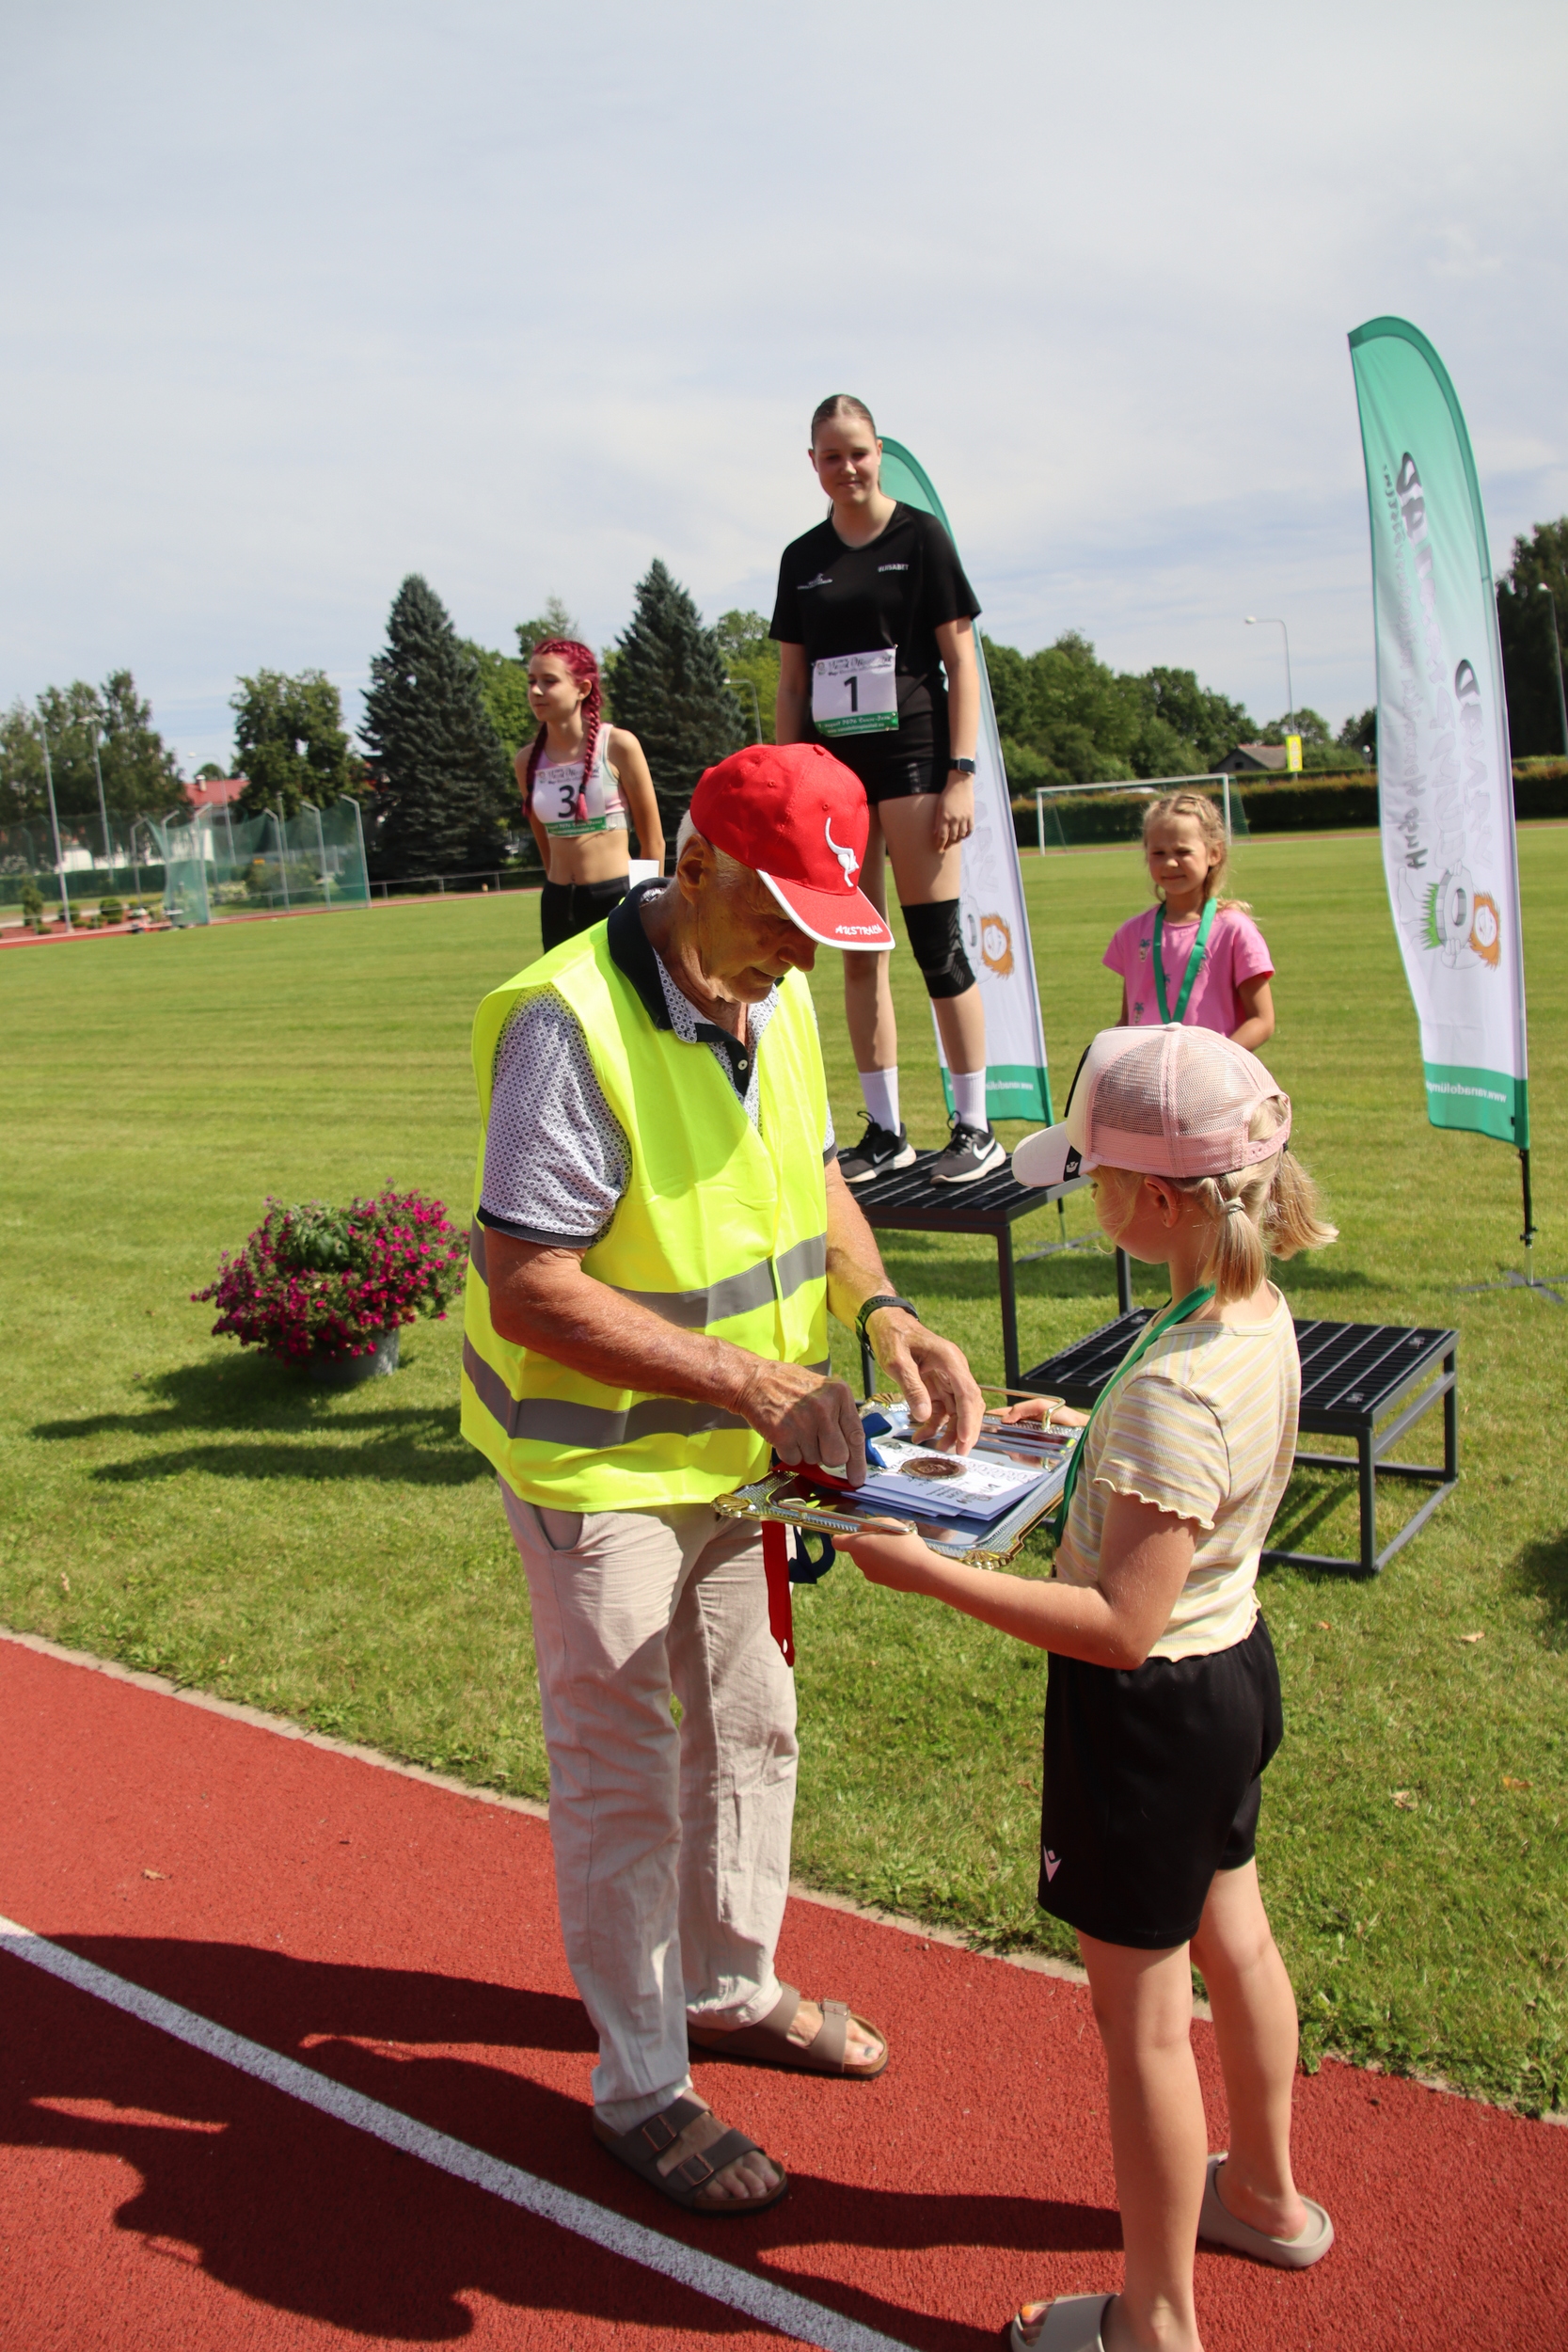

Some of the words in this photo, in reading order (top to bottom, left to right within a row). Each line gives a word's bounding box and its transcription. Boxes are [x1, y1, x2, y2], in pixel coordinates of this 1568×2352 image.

[844, 675, 858, 712] 1
[558, 785, 576, 818] 3
[835, 923, 883, 935] AUSTRALIA
